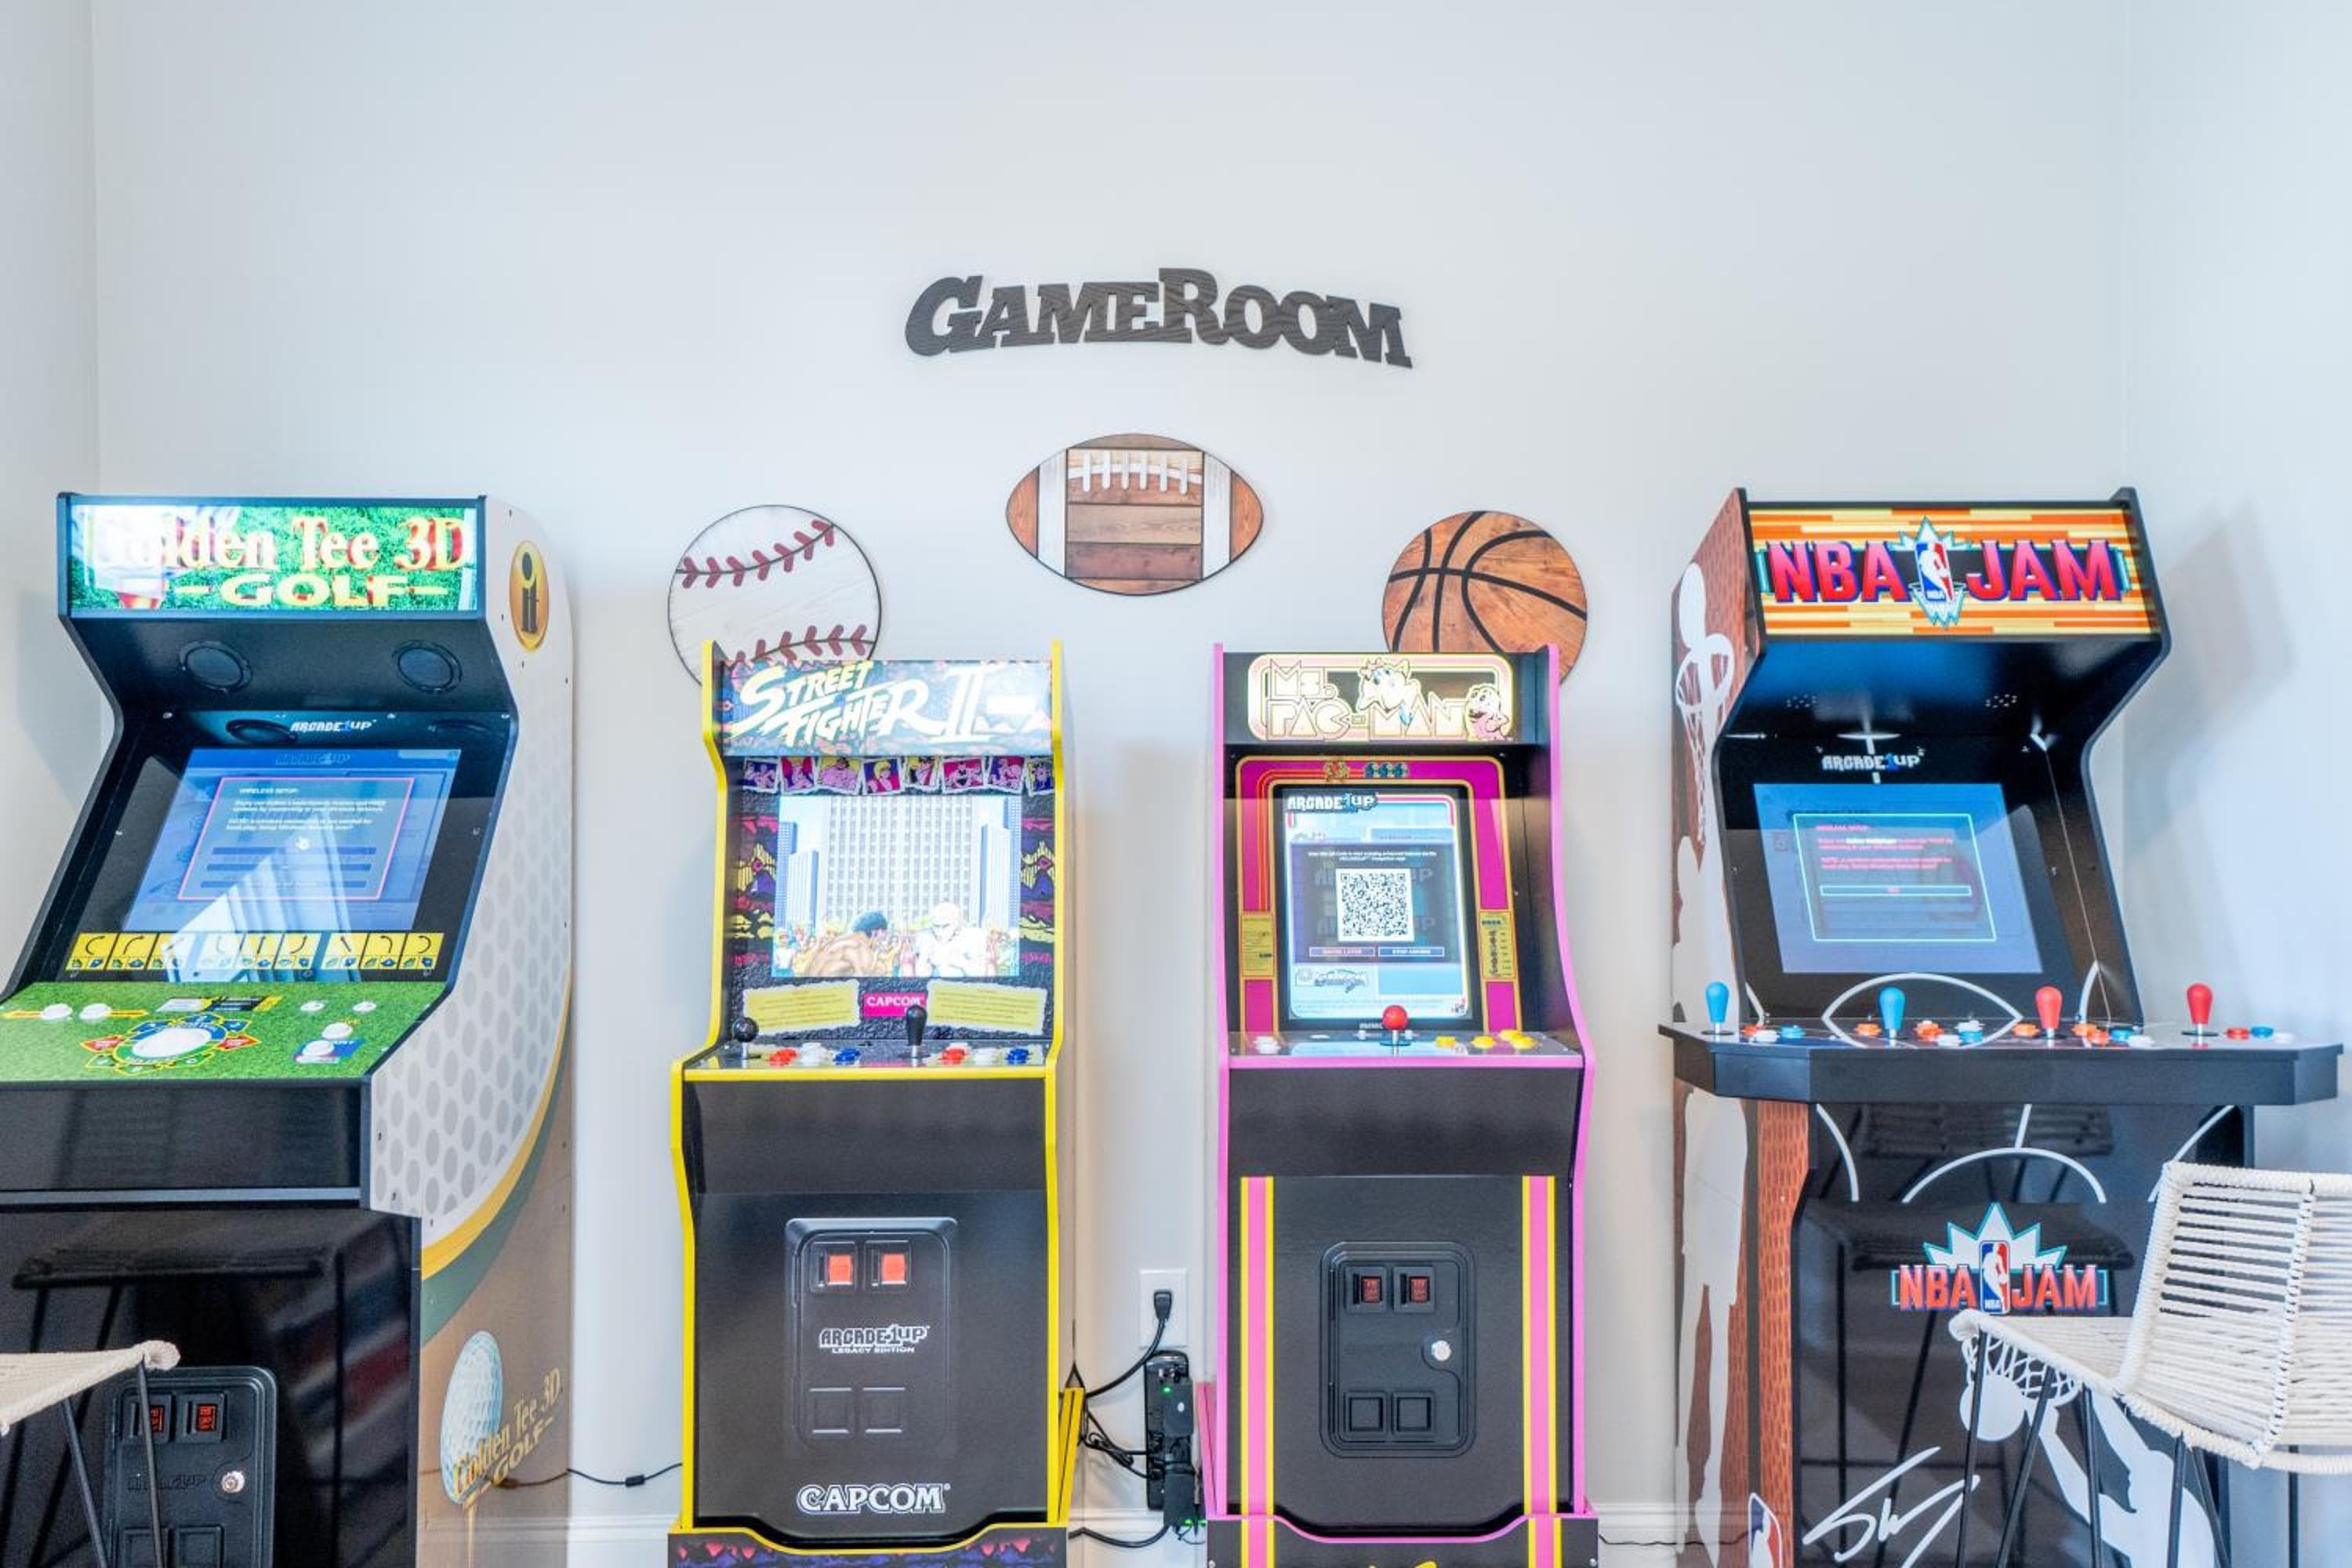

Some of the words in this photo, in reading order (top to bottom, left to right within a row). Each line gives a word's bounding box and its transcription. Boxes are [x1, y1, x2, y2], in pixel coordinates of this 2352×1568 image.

[100, 515, 278, 570] lden
[292, 515, 379, 572] Tee
[396, 516, 468, 572] 3D
[1766, 539, 1908, 603] NBA
[1965, 539, 2120, 601] JAM
[727, 661, 874, 739] STREET
[754, 679, 950, 747] FIGHTER
[866, 995, 921, 1007] CAPCOM
[1899, 1264, 1978, 1310] NBA
[2012, 1264, 2099, 1309] JAM
[454, 1424, 510, 1497] Golden
[514, 1398, 539, 1440] Tee
[543, 1367, 561, 1412] 3D
[493, 1420, 544, 1485] GOLF
[797, 1483, 946, 1515] CAPCOM
